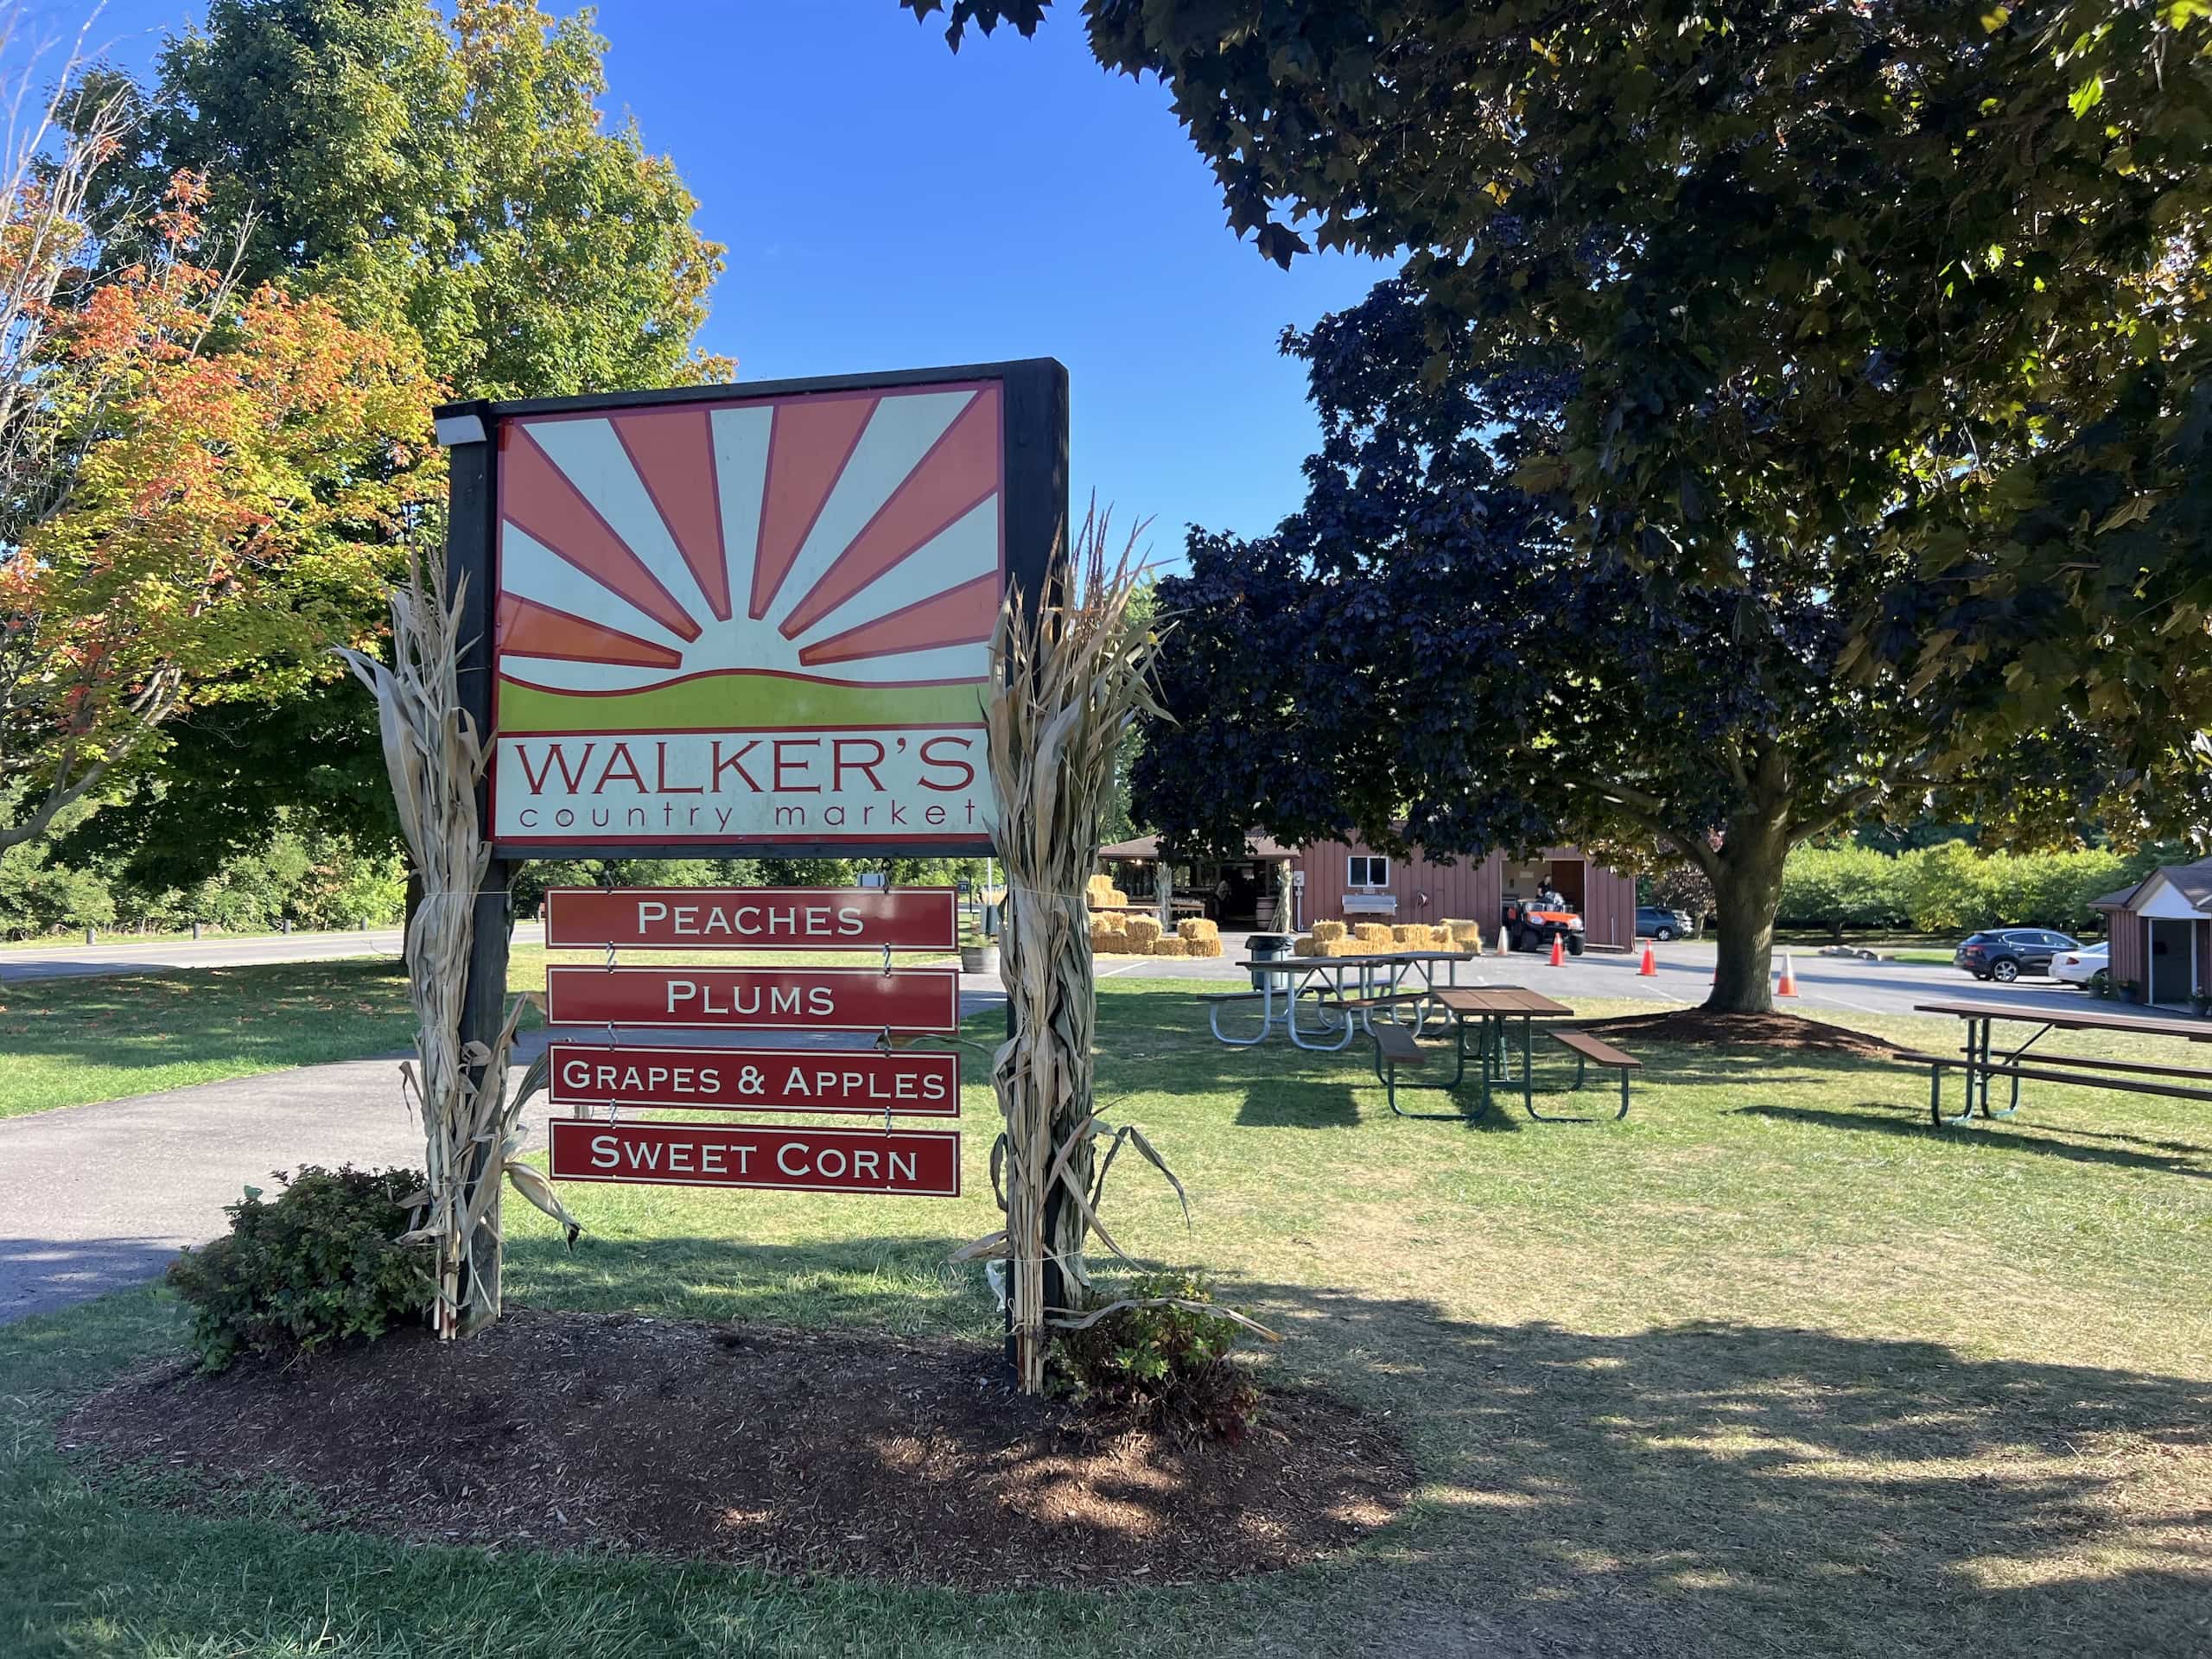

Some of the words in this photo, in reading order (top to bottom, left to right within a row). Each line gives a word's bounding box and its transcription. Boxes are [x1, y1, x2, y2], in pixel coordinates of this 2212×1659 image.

[514, 737, 976, 795] WALKER'S
[519, 802, 733, 832] country
[775, 798, 975, 826] market
[638, 901, 865, 936] PEACHES
[666, 981, 835, 1015] PLUMS
[563, 1060, 721, 1094] GRAPES
[738, 1065, 766, 1095] &
[782, 1067, 946, 1100] APPLES
[591, 1135, 757, 1174] SWEET
[777, 1142, 917, 1181] CORN
